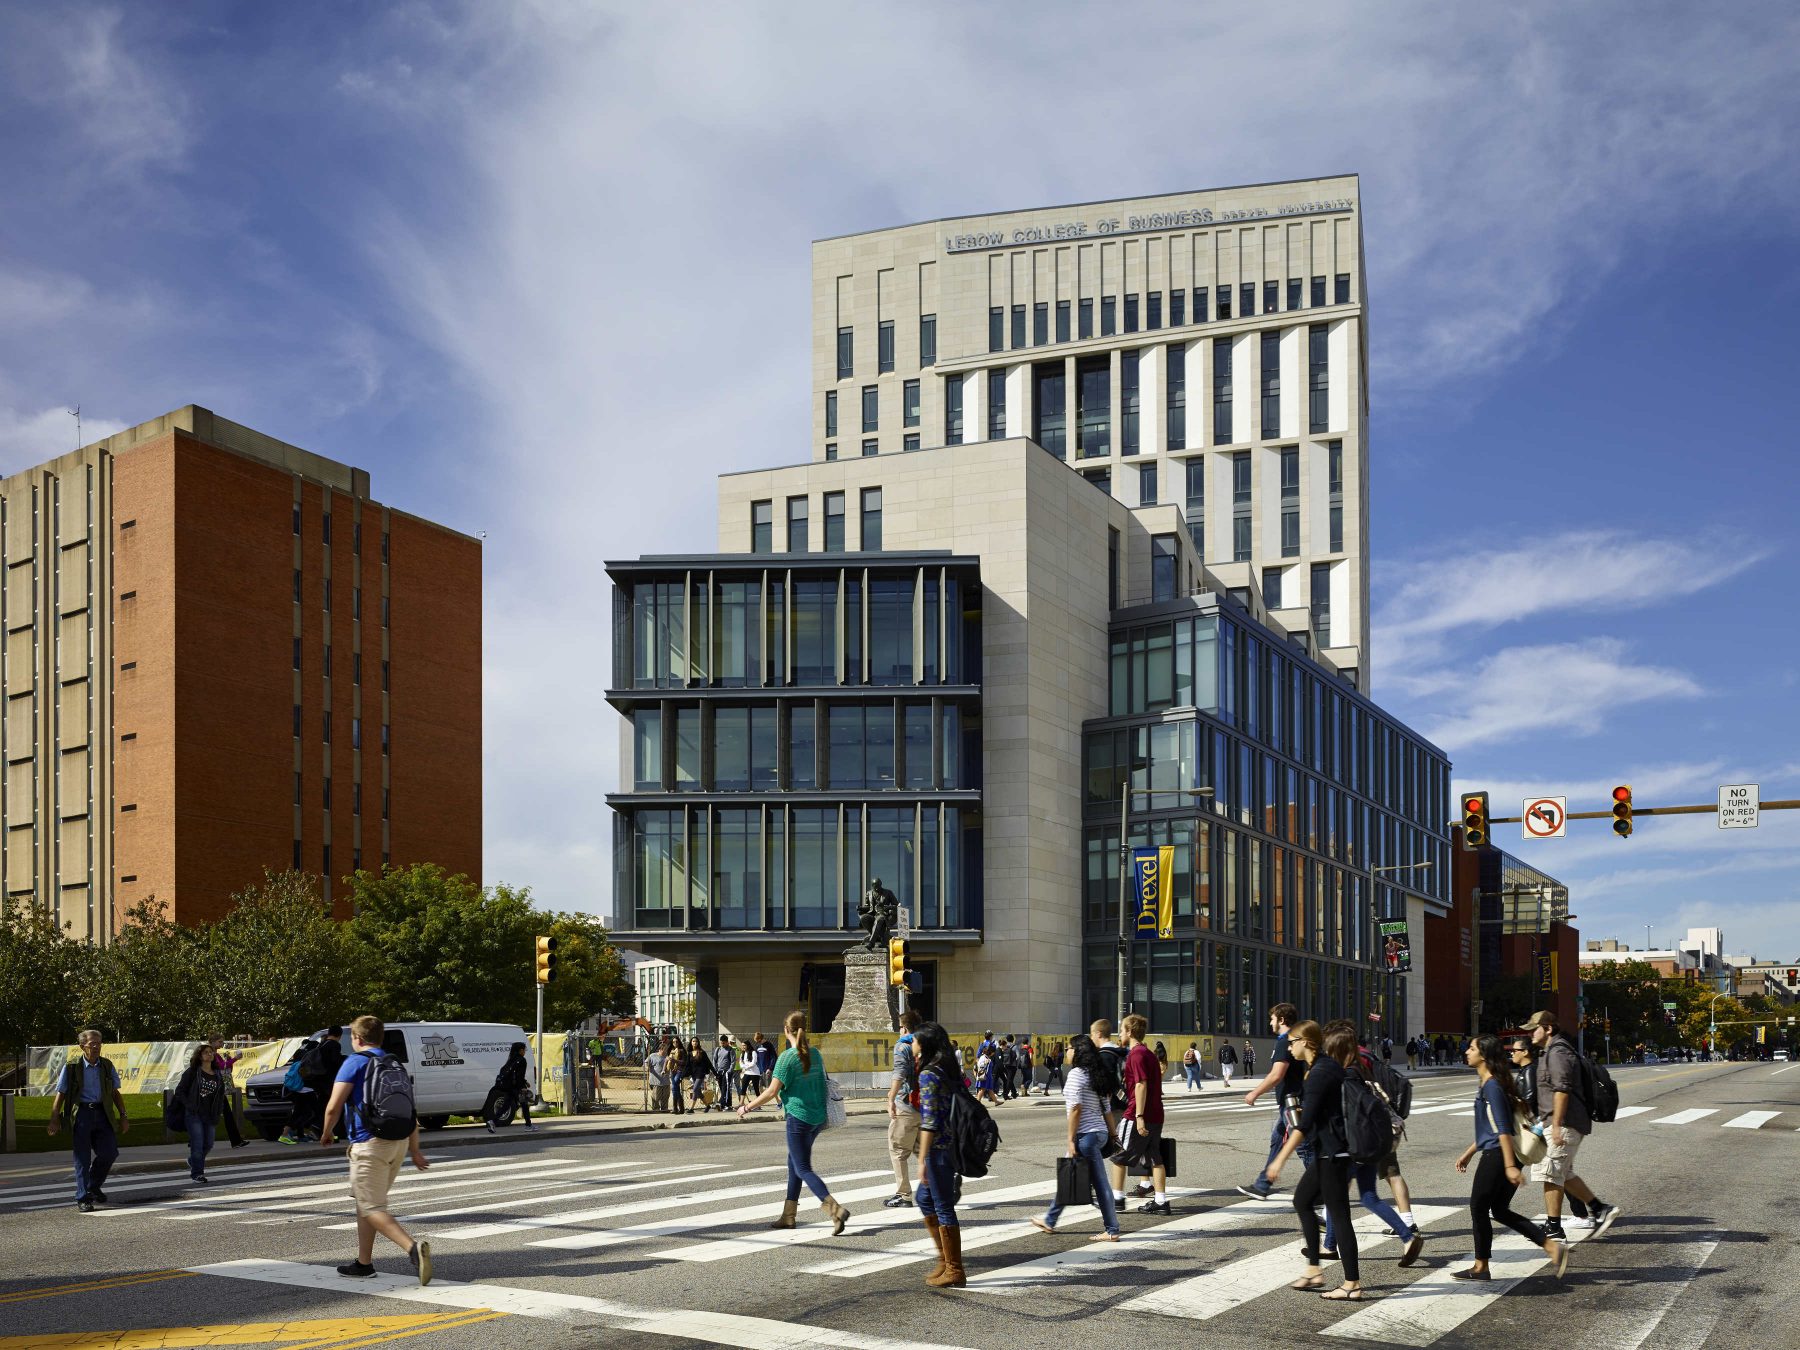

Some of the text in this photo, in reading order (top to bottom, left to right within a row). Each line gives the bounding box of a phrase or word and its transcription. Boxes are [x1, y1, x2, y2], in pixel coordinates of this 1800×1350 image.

[946, 231, 1004, 250] LEBOW
[1012, 222, 1088, 242] COLLEGE
[1096, 217, 1120, 233] OF
[1128, 208, 1213, 230] BUSINESS
[1727, 799, 1749, 807] TURN
[1730, 788, 1747, 798] NO
[1737, 808, 1755, 816] RED
[1136, 854, 1157, 932] Drexel
[1538, 956, 1551, 991] Drexel
